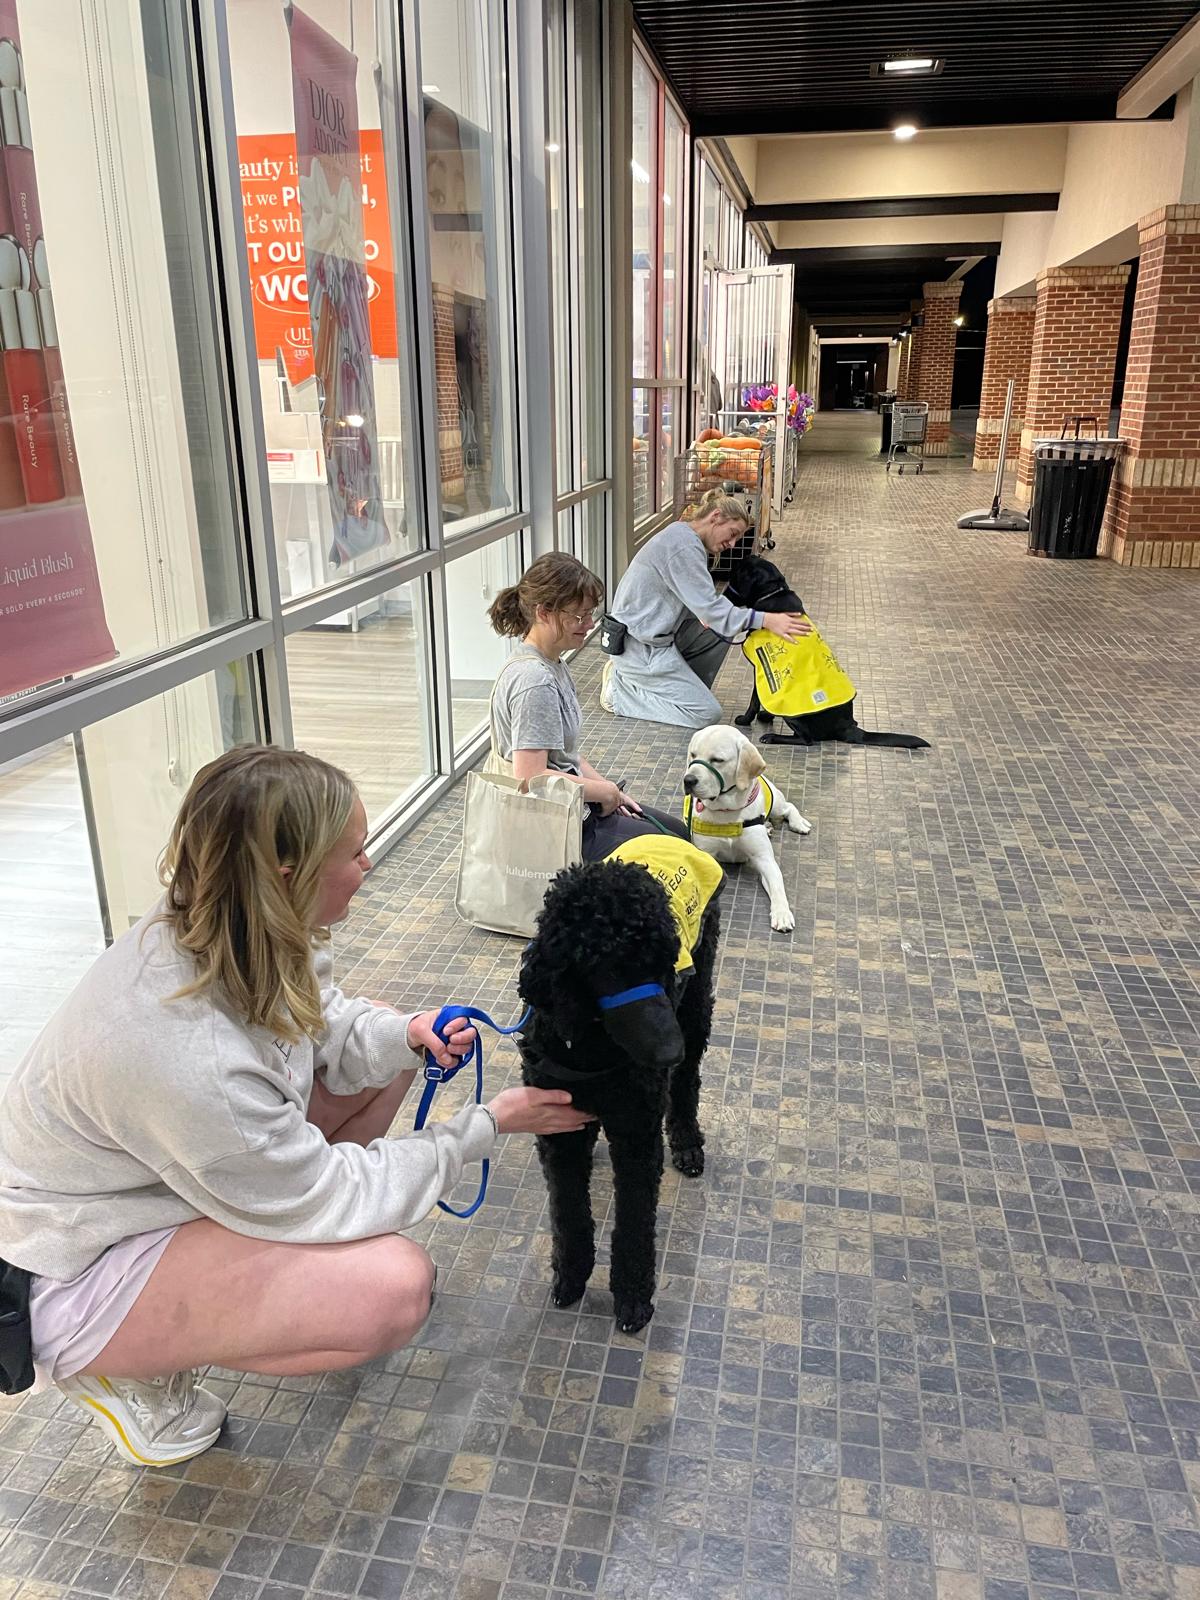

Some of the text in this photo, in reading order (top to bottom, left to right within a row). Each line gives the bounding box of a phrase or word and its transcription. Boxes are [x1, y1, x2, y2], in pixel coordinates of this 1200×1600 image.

[308, 78, 347, 139] DIOR
[255, 193, 278, 206] we
[268, 241, 304, 263] OU
[22, 394, 39, 469] Rare Beauty
[40, 551, 74, 575] Blush
[5, 602, 24, 615] SOLD
[25, 597, 47, 609] EVERY
